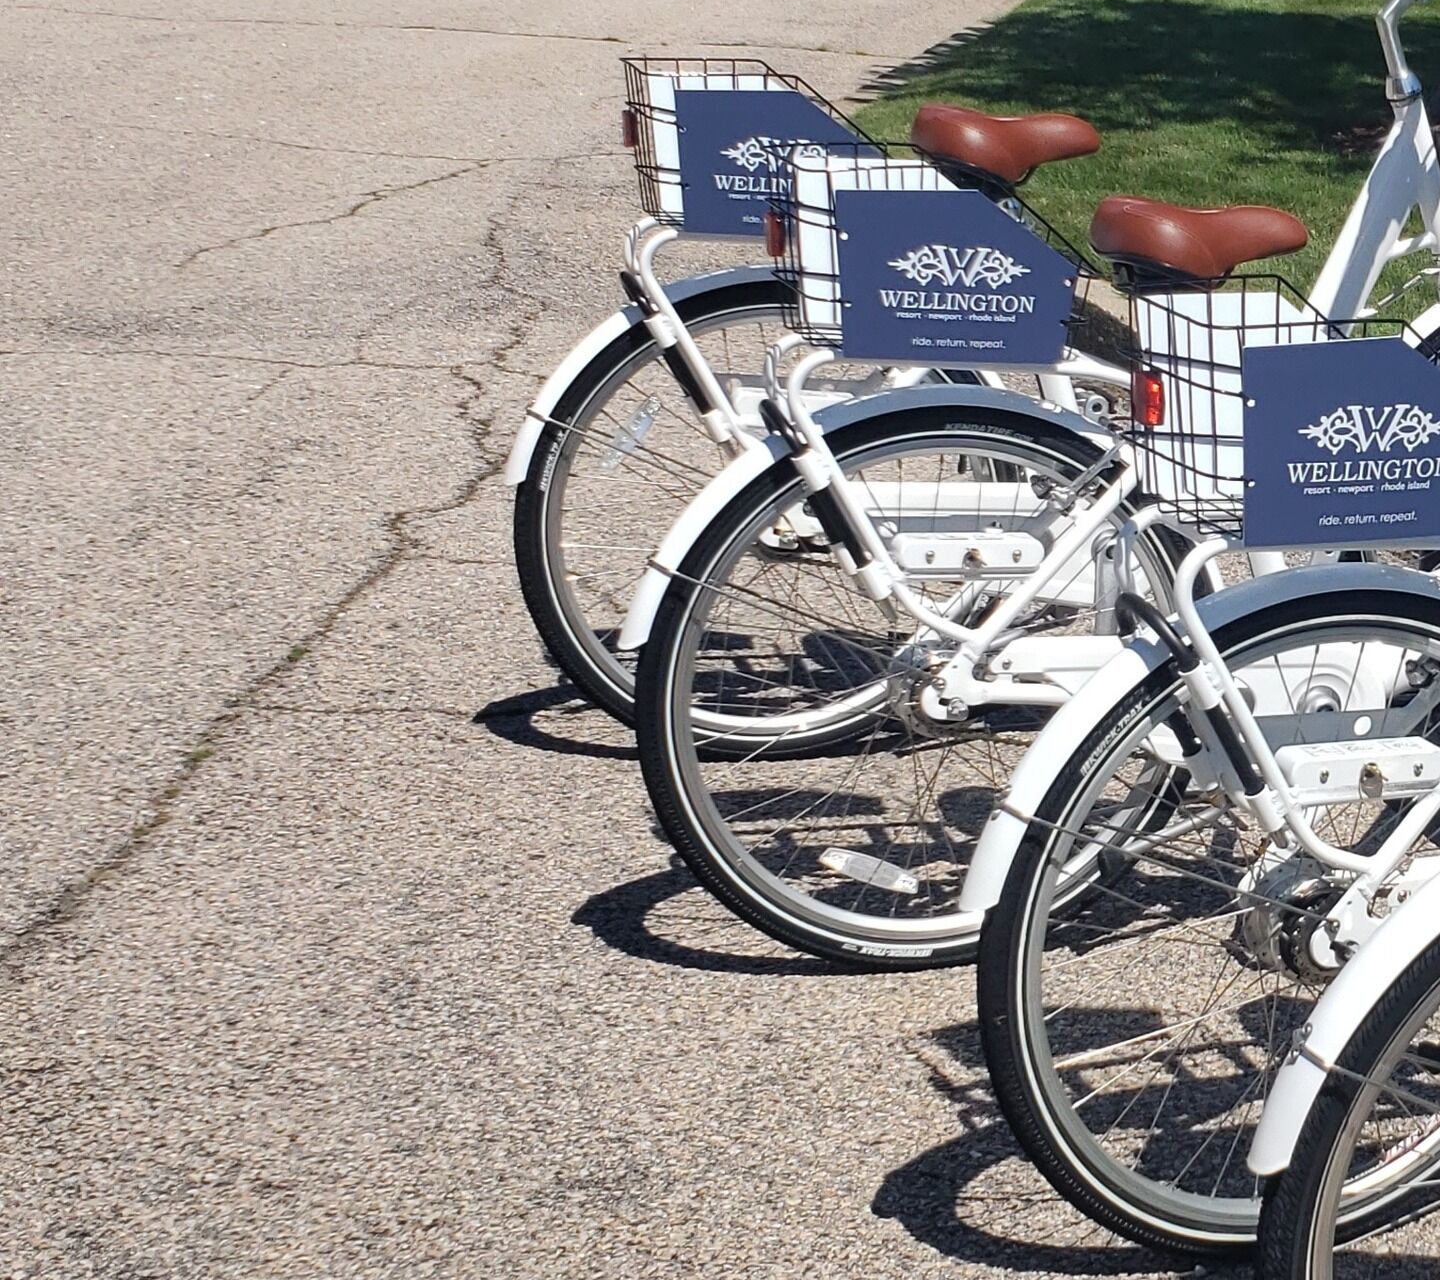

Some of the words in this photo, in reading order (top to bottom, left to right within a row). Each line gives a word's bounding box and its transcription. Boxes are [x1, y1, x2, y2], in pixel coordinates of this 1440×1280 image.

[713, 174, 793, 194] WELLIN
[879, 289, 1035, 313] WELLINGTON
[896, 311, 921, 320] resort
[928, 313, 962, 322] newport
[969, 313, 993, 322] rhode
[912, 336, 935, 347] ride.
[1303, 486, 1331, 495] resort
[1337, 484, 1374, 495] newport
[1381, 482, 1406, 491] rhode
[1407, 480, 1430, 491] island
[1319, 514, 1342, 526] ride.
[1344, 512, 1378, 525] return.
[1379, 510, 1418, 524] repeat.
